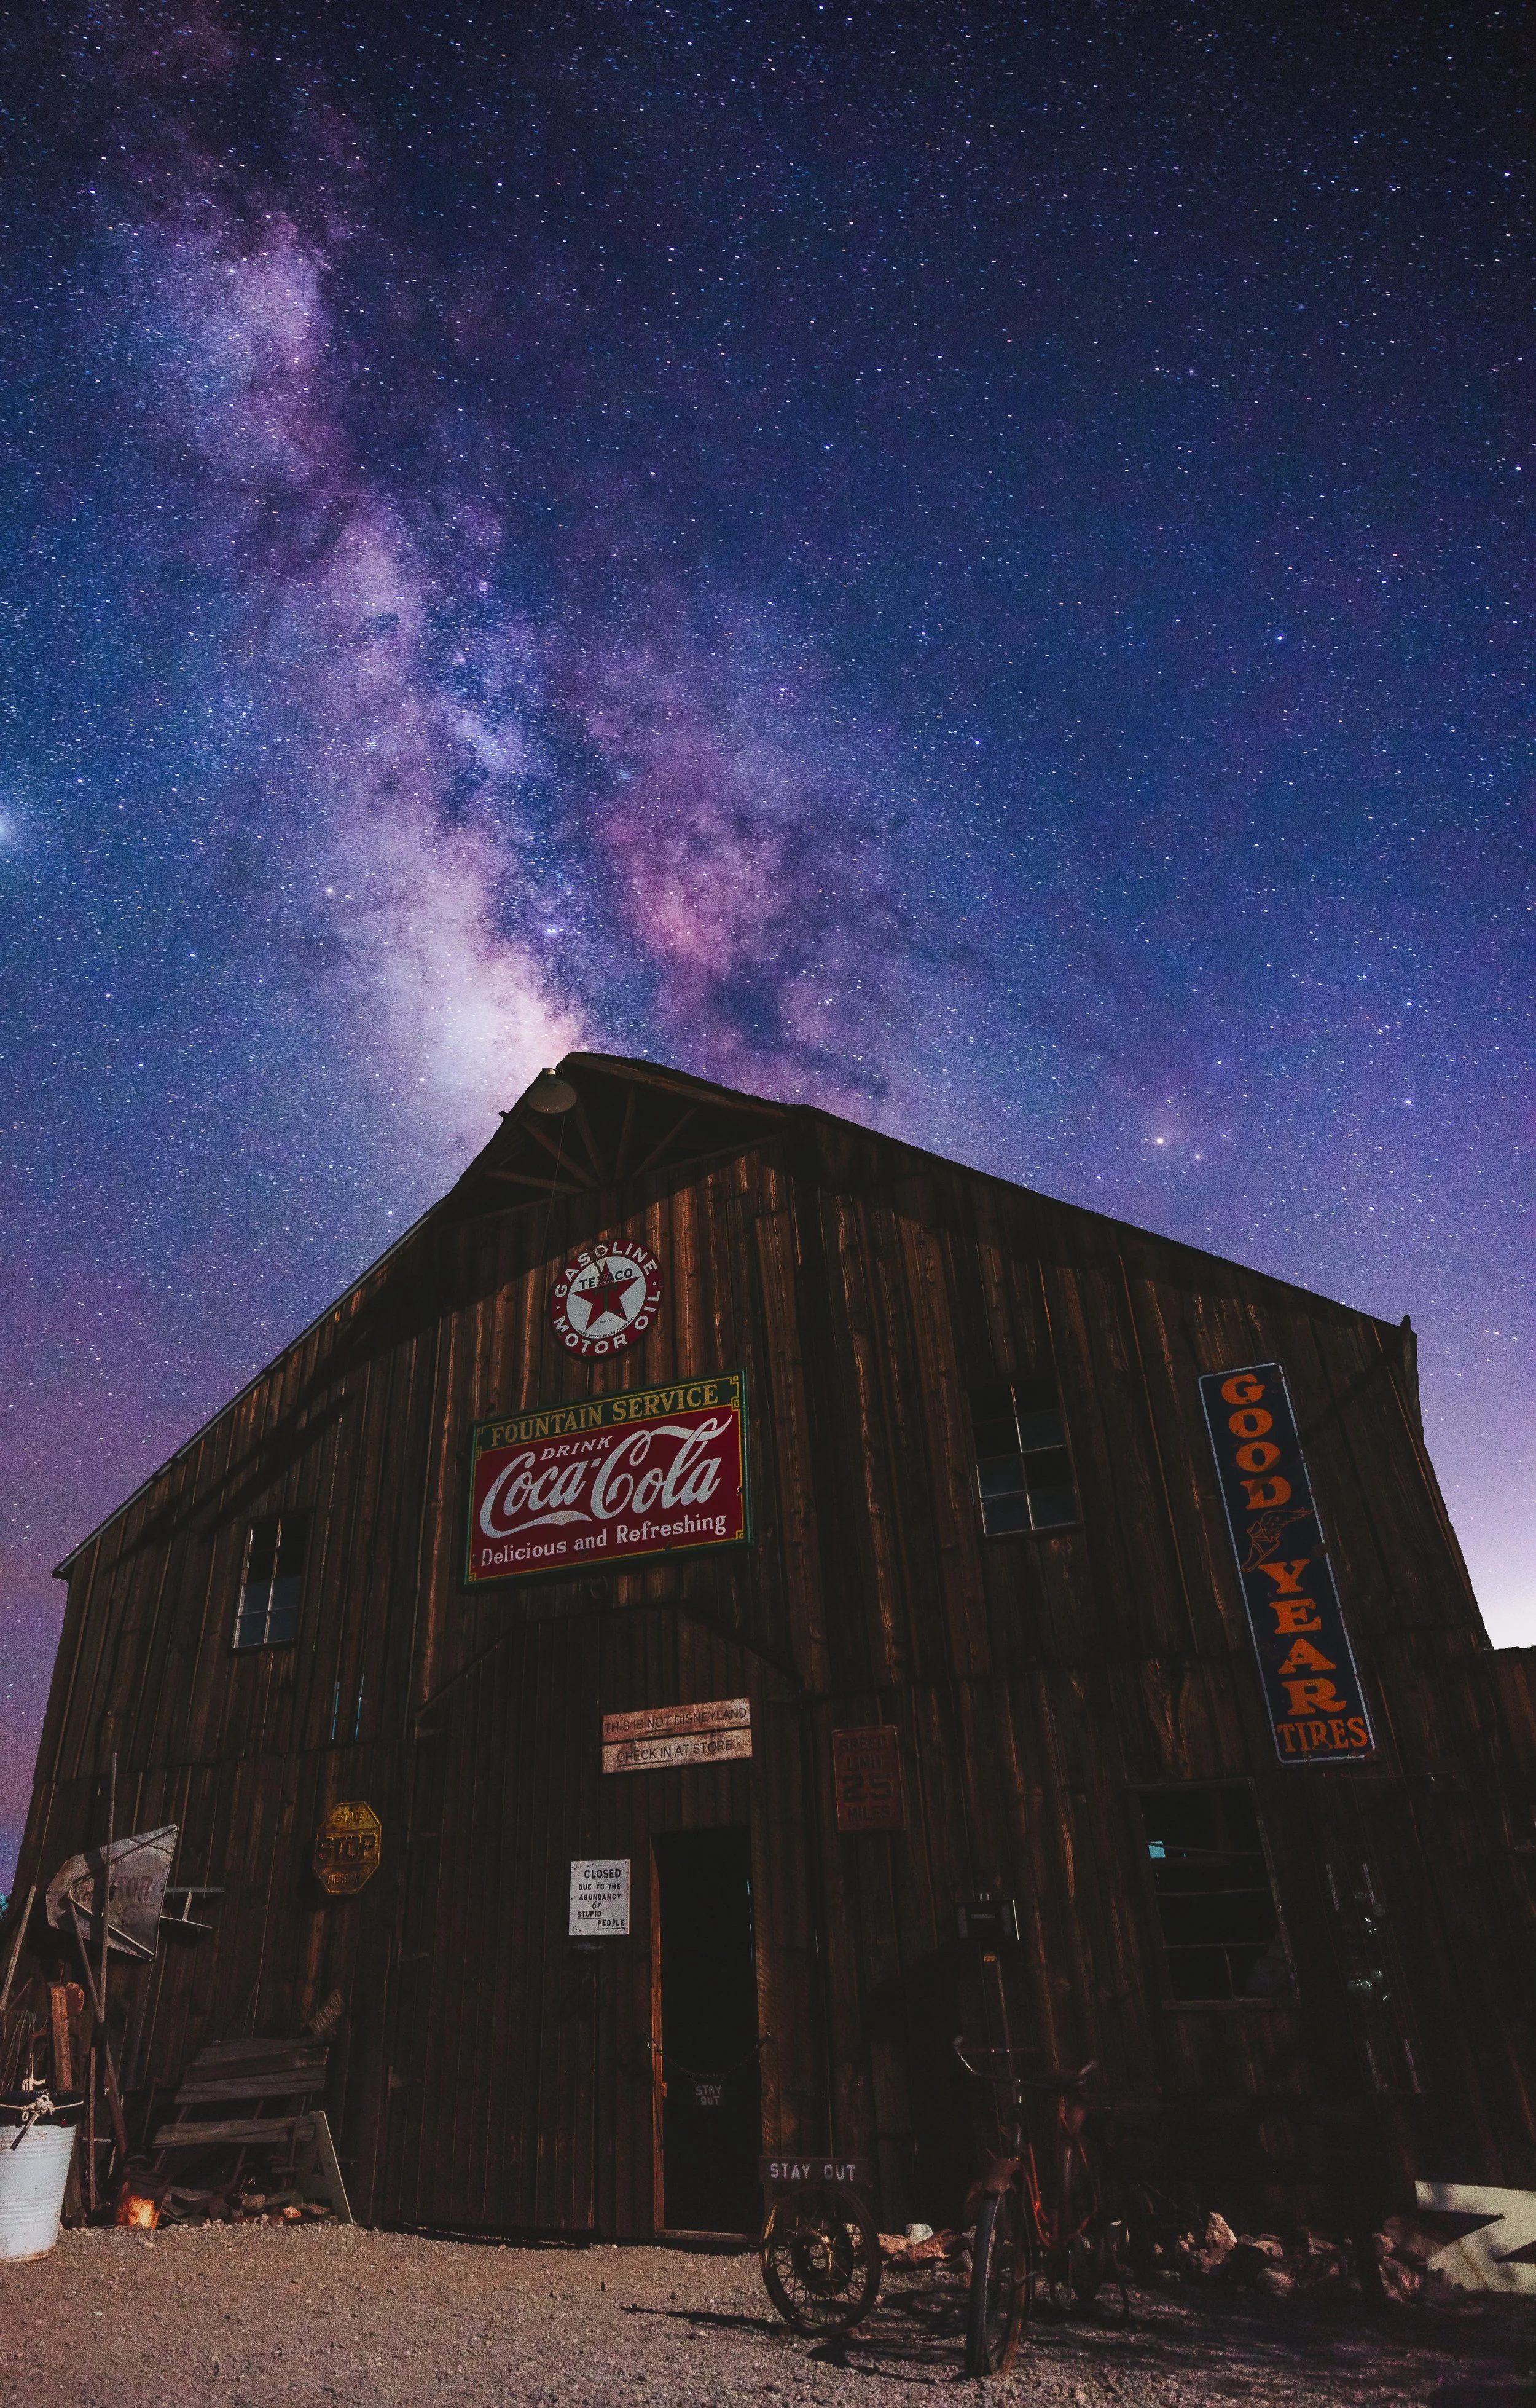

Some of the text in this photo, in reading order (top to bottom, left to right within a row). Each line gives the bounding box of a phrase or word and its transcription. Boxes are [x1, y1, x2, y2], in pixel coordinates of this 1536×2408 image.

[555, 1242, 658, 1298] GASOLINE
[579, 1269, 633, 1289] TEXACO
[594, 1285, 618, 1312] T
[554, 1291, 660, 1354] MOTOR OIL
[617, 1316, 635, 1332] COMPANY
[491, 1384, 718, 1447] FOUNTAIN SERVICE
[540, 1436, 613, 1460] DRINK
[480, 1415, 733, 1538] Coca-Cola
[482, 1515, 726, 1567] Delicious and Refreshing
[604, 1708, 747, 1733] THIS IS NOT DISNEYLAND
[1277, 1717, 1368, 1753] TIRES
[617, 1739, 733, 1763] CHECK IN AT STORE
[842, 1773, 892, 1802] 25
[317, 1834, 377, 1860] STOP
[327, 1873, 361, 1884] HIGHWAY
[584, 1868, 621, 1879] CLOSED
[695, 2084, 722, 2096] STAY
[700, 2095, 720, 2106] OUT
[770, 2163, 856, 2181] STAY OUT
